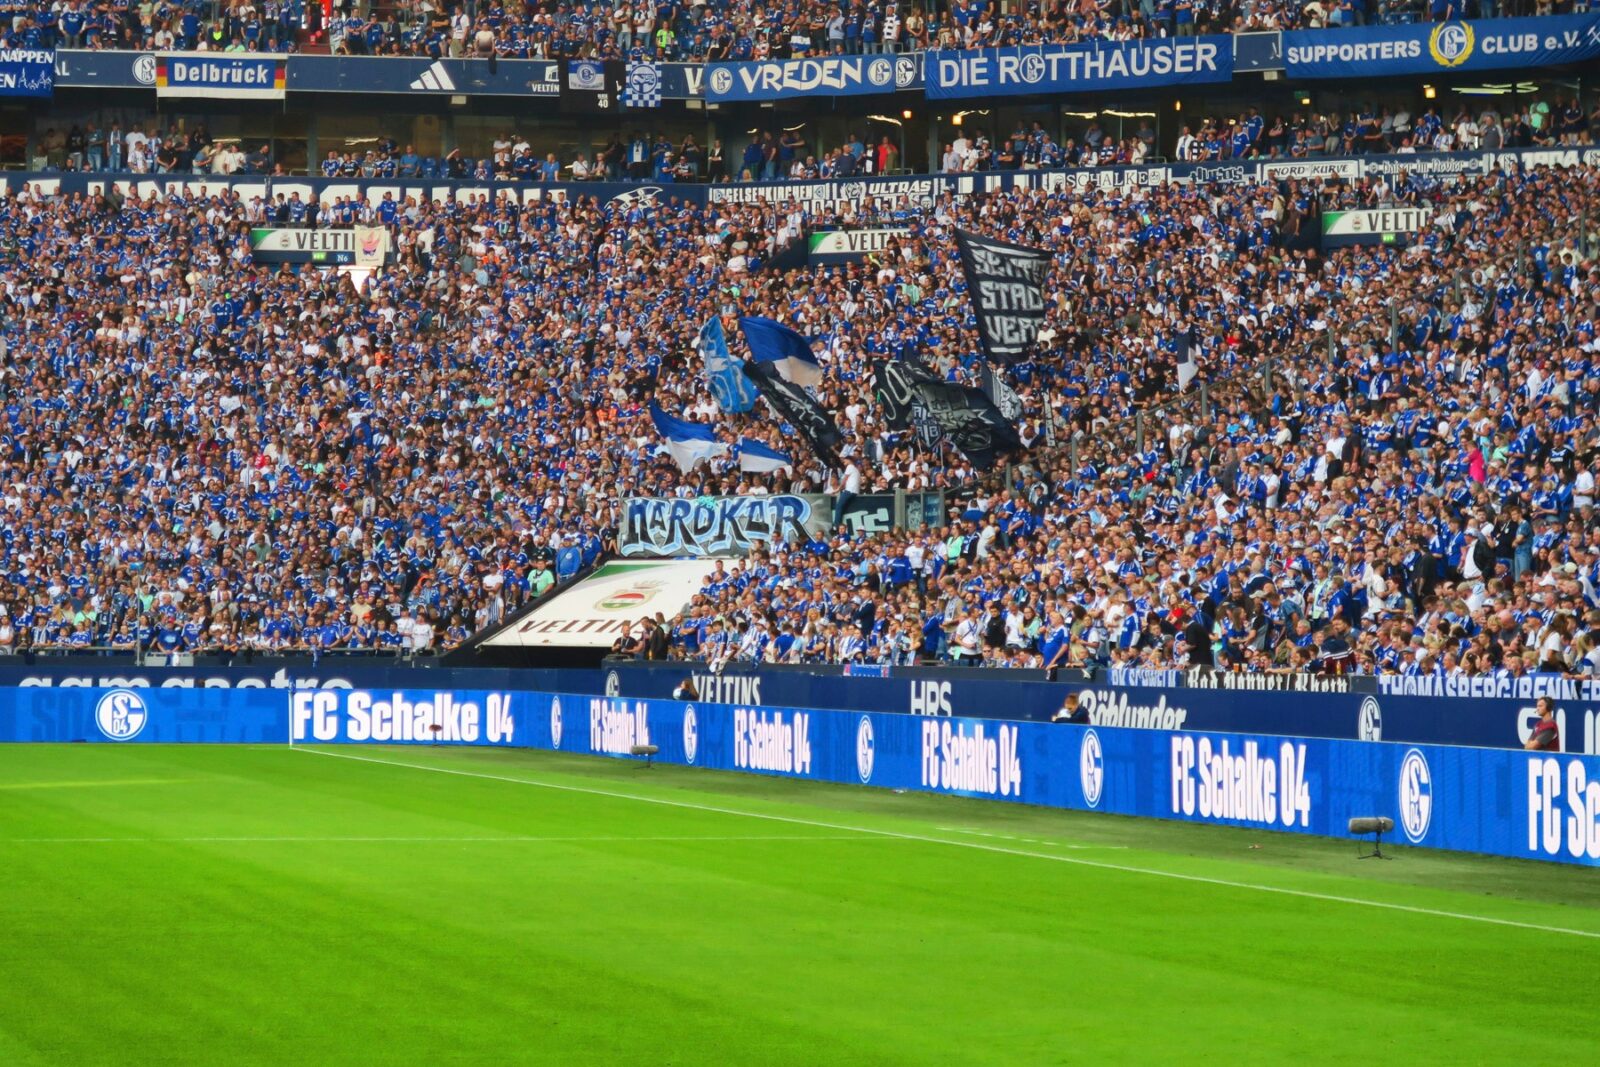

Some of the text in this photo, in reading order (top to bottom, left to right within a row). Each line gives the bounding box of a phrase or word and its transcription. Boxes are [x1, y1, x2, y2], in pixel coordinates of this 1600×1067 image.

[1287, 30, 1582, 64] SUPPORTERS CLUB e.V.
[174, 61, 269, 84] Delbrück
[738, 57, 863, 94] VREDEN
[940, 57, 989, 88] DIE
[868, 180, 932, 195] ULTRAS
[1066, 170, 1149, 189] SCHALKE
[1273, 164, 1349, 176] NORD KURVE
[725, 185, 813, 202] GELSENKIRCHEN
[293, 691, 514, 743] FC Schalke 04
[591, 699, 649, 756] FC Schalke 04
[734, 709, 811, 774] FC Schalke 04
[922, 720, 1021, 796] FC Schalke 04
[1171, 736, 1311, 827] FC Schalke 04
[1528, 757, 1561, 855] FC
